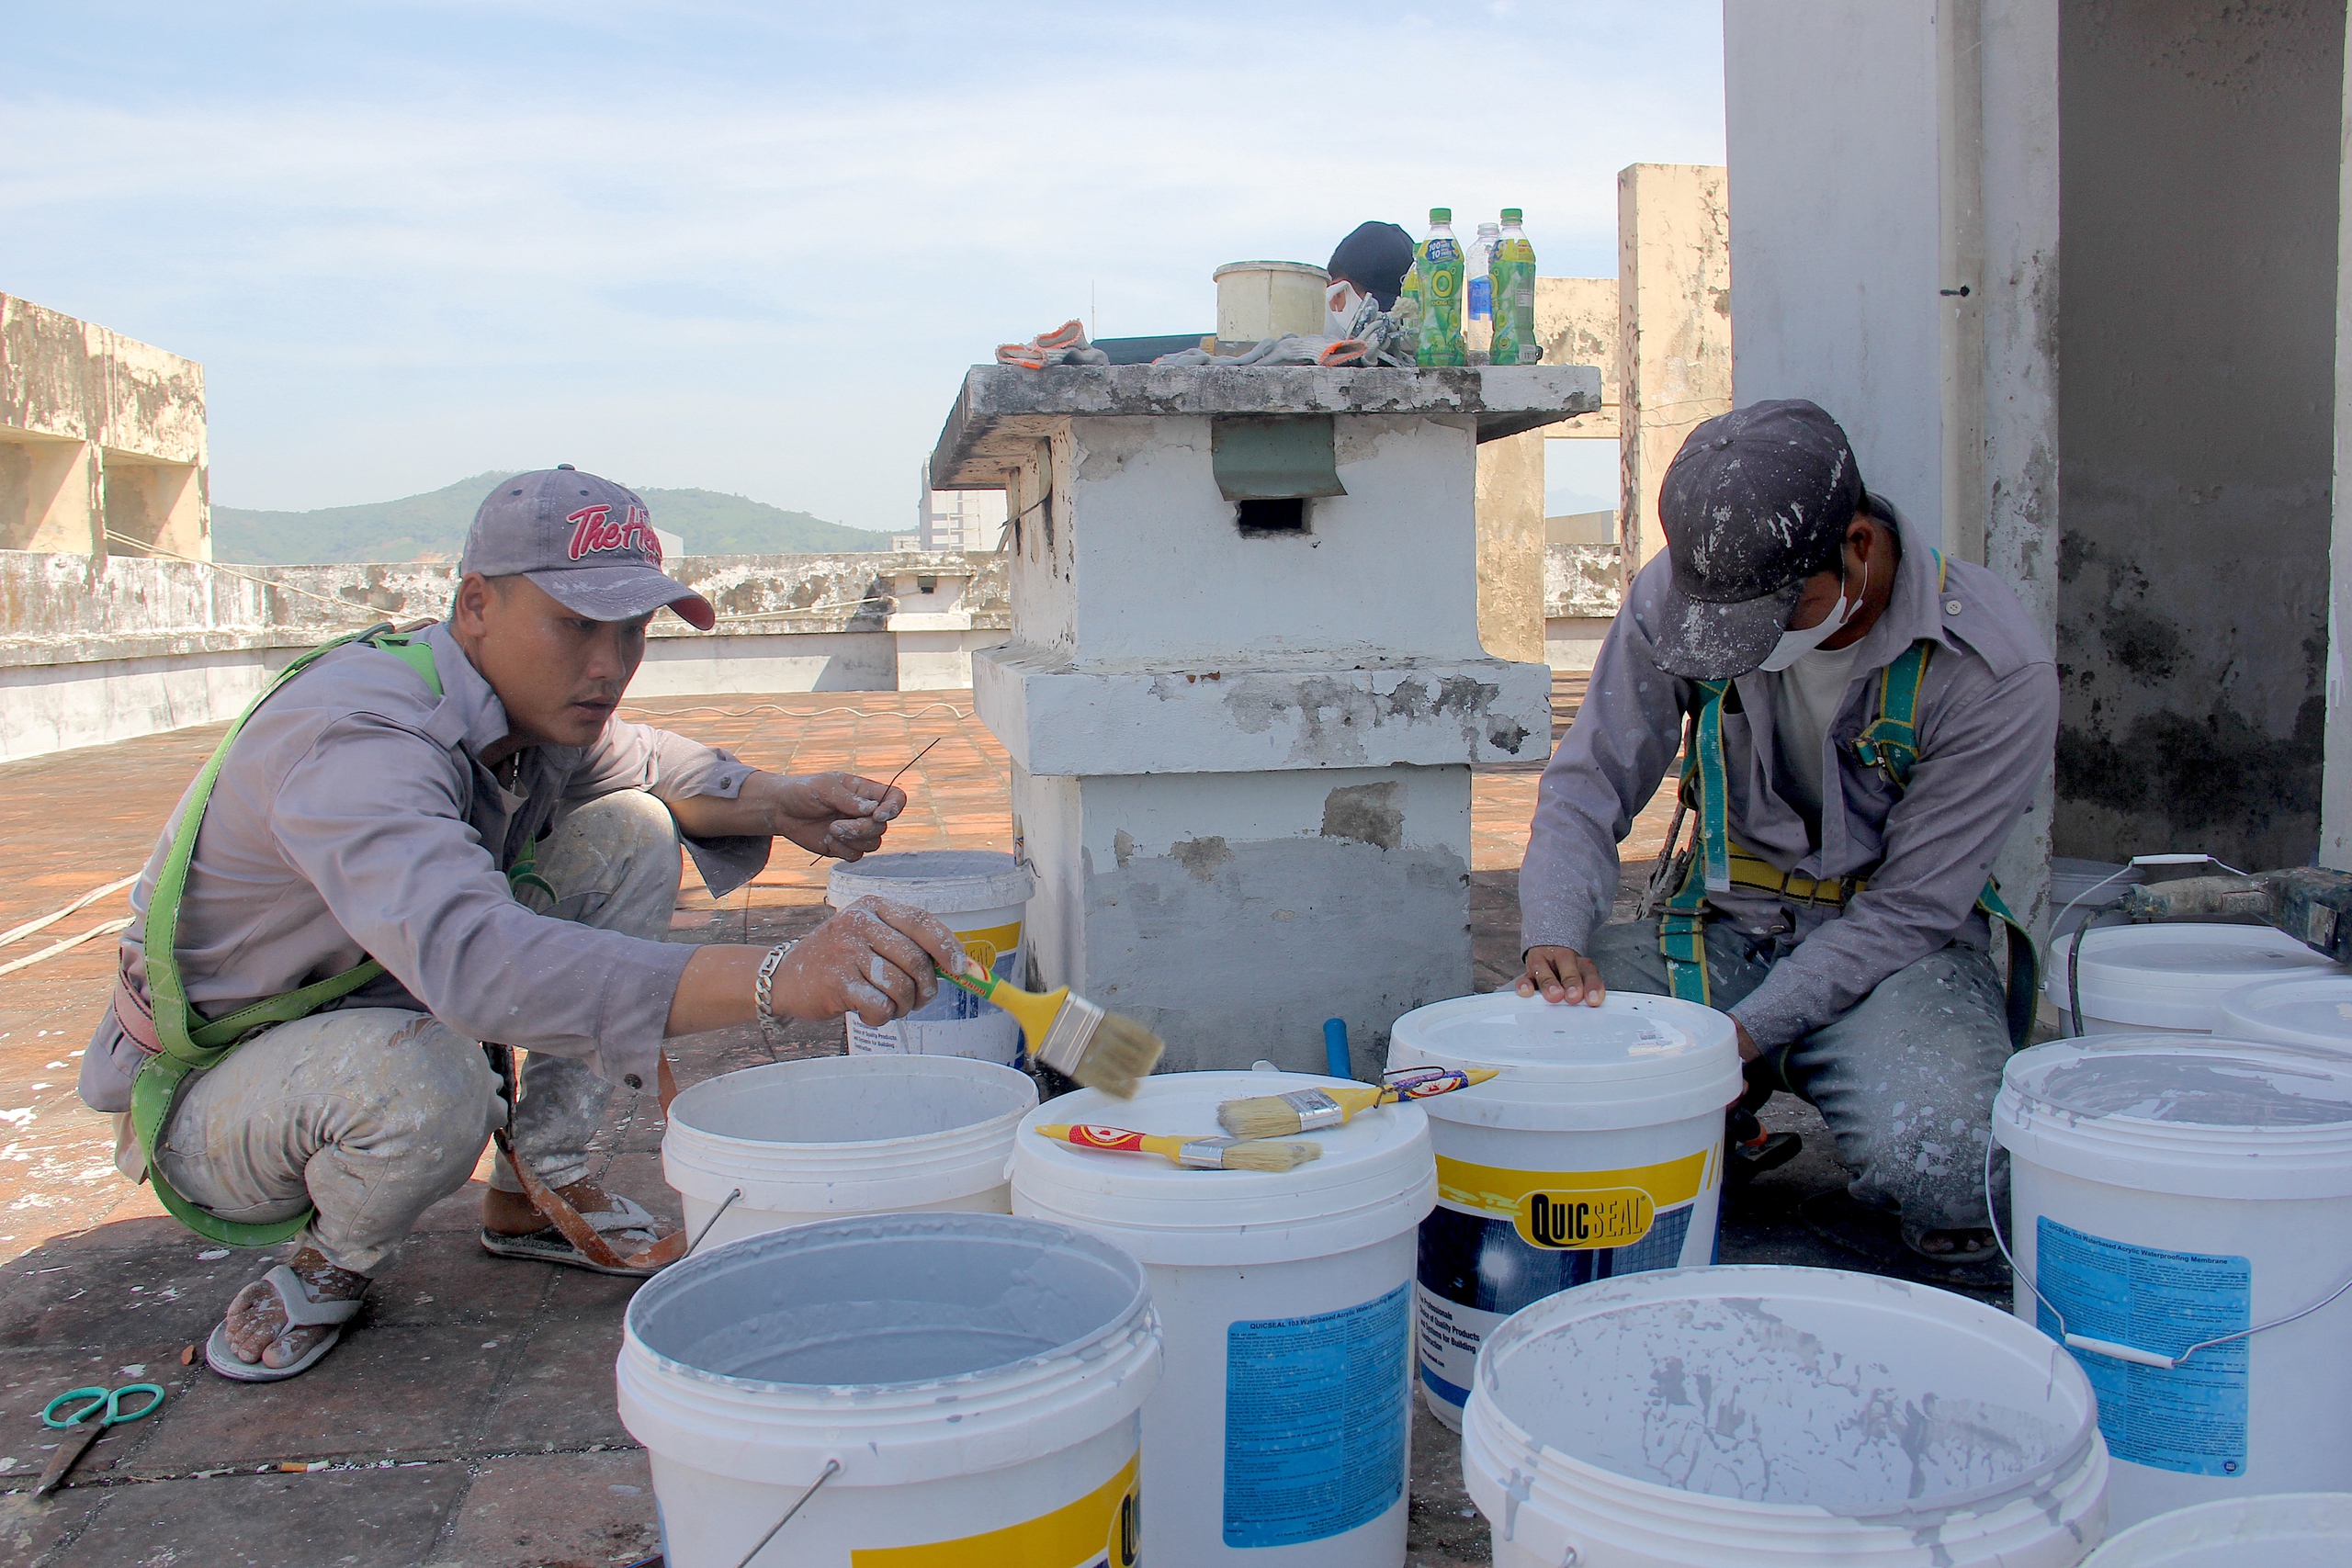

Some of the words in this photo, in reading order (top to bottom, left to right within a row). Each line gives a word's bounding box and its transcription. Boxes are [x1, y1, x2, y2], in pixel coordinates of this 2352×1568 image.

[2047, 1222, 2072, 1237] QUICSEAL
[2073, 1232, 2082, 1240] 103
[2082, 1235, 2116, 1250] Waterbased
[2117, 1245, 2140, 1255] Acrylic
[2141, 1249, 2189, 1263] Waterproofing
[2190, 1256, 2228, 1265] Membrane
[1250, 1321, 1286, 1330] QUICSEAL
[1300, 1314, 1336, 1325] Waterbased
[1337, 1309, 1355, 1320] Acrylic
[1355, 1297, 1387, 1314] Waterproofing
[1434, 1316, 1451, 1333] Quality
[1452, 1325, 1480, 1342] Products
[1451, 1337, 1476, 1355] Building
